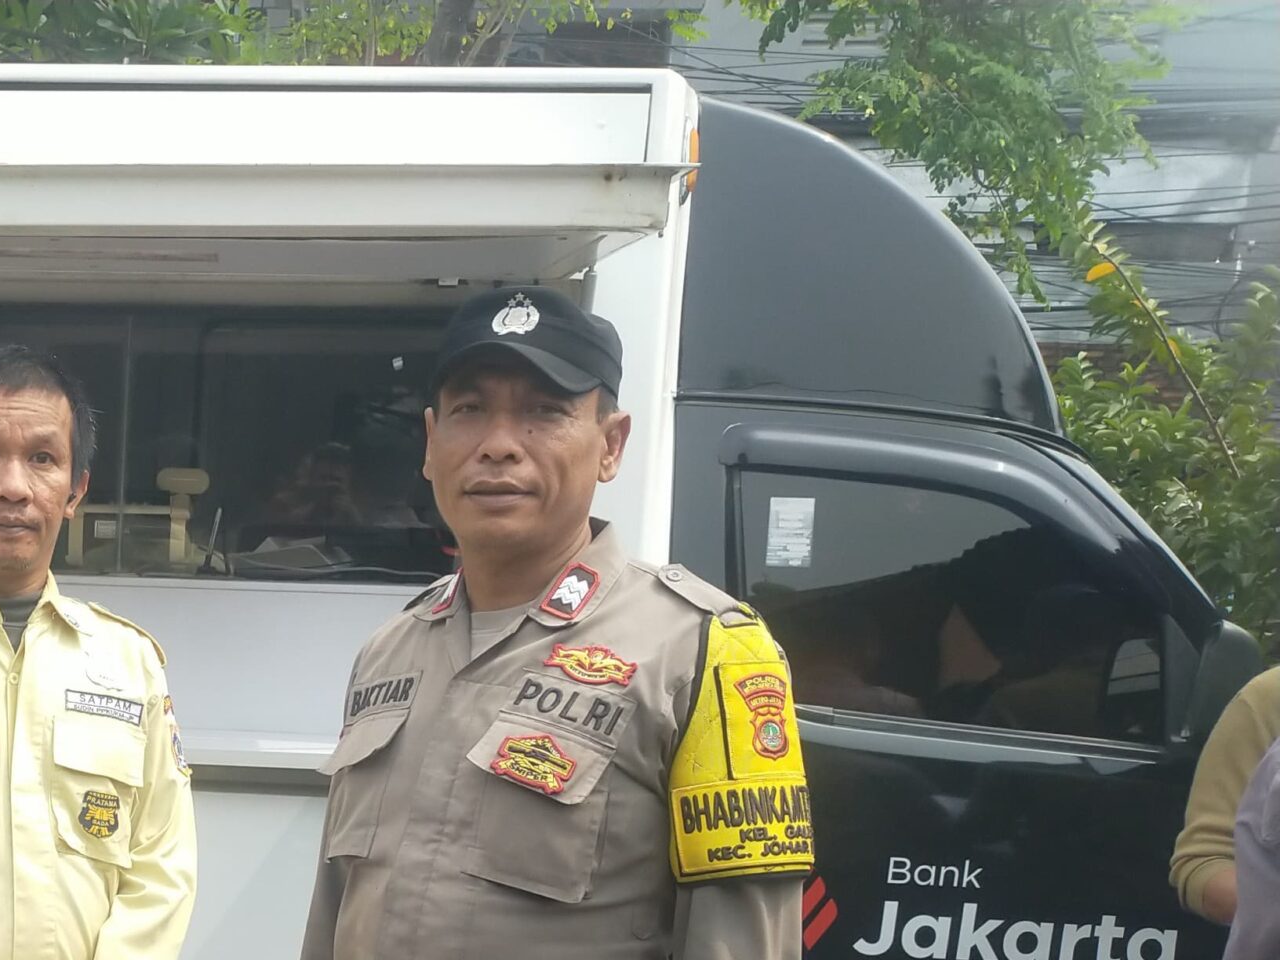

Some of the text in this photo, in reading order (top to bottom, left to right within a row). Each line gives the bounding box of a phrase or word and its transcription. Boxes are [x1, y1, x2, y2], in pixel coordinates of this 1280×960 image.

[79, 693, 132, 713] SATPAM
[513, 678, 625, 737] POLRI
[740, 827, 778, 843] KEL.
[707, 844, 753, 863] KEC.
[886, 856, 984, 889] Bank
